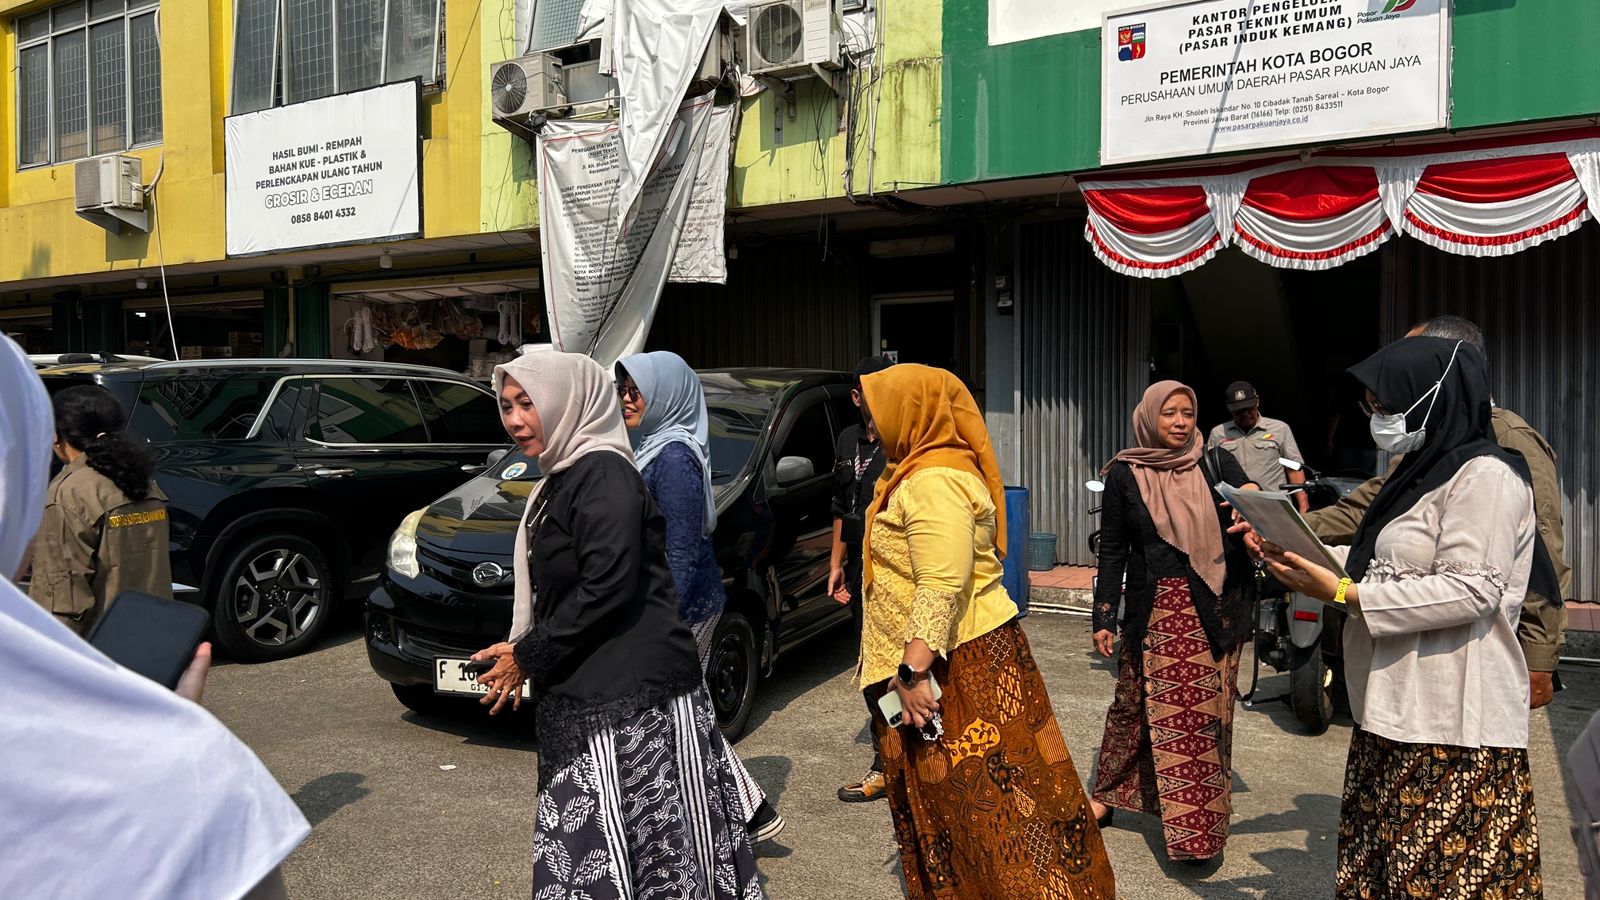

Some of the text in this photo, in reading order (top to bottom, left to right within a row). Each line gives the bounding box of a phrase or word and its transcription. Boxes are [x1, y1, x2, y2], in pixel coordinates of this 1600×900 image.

[1188, 4, 1342, 39] PASAR TEKNIK UMUM
[1192, 0, 1339, 26] KANTOR PENGELO
[1356, 13, 1401, 25] Pakuan Jaya
[1357, 10, 1379, 18] Pasar
[1178, 16, 1352, 55] (PASAR INDUK KEMANG)
[1160, 41, 1373, 85] PEMERINTAH KOTA BOGOR
[1121, 54, 1422, 106] PERUSAHAAN UMUM DAERAH PASAR PAKUAN JAYA
[1144, 115, 1154, 123] Jln
[1155, 113, 1171, 123] Raya
[1186, 108, 1209, 118] Sholeh
[1210, 103, 1239, 115] Iskandar
[1241, 102, 1253, 111] No.
[1254, 101, 1261, 109] 10
[1263, 97, 1291, 109] Cibadak
[1292, 94, 1314, 105] Tanah
[1315, 91, 1340, 101] Sareal
[1347, 88, 1365, 97] Kota
[1366, 85, 1390, 97] Bogor
[1183, 100, 1343, 128] Provinsi Jawa Barat (16166) Telp: (0251) 8433511
[268, 161, 298, 175] BAHAN
[299, 158, 316, 170] KUE
[322, 151, 359, 166] PLASTIK
[360, 149, 367, 160] &
[272, 148, 296, 161] HASIL
[297, 144, 319, 157] BUMI
[325, 135, 363, 152] REMPAH
[255, 160, 383, 190] PERLENGKAPAN ULANG TAHUN
[265, 178, 374, 210] GROSIR & ECERAN
[291, 206, 357, 225] 0858 8401 4332
[439, 660, 448, 680] F
